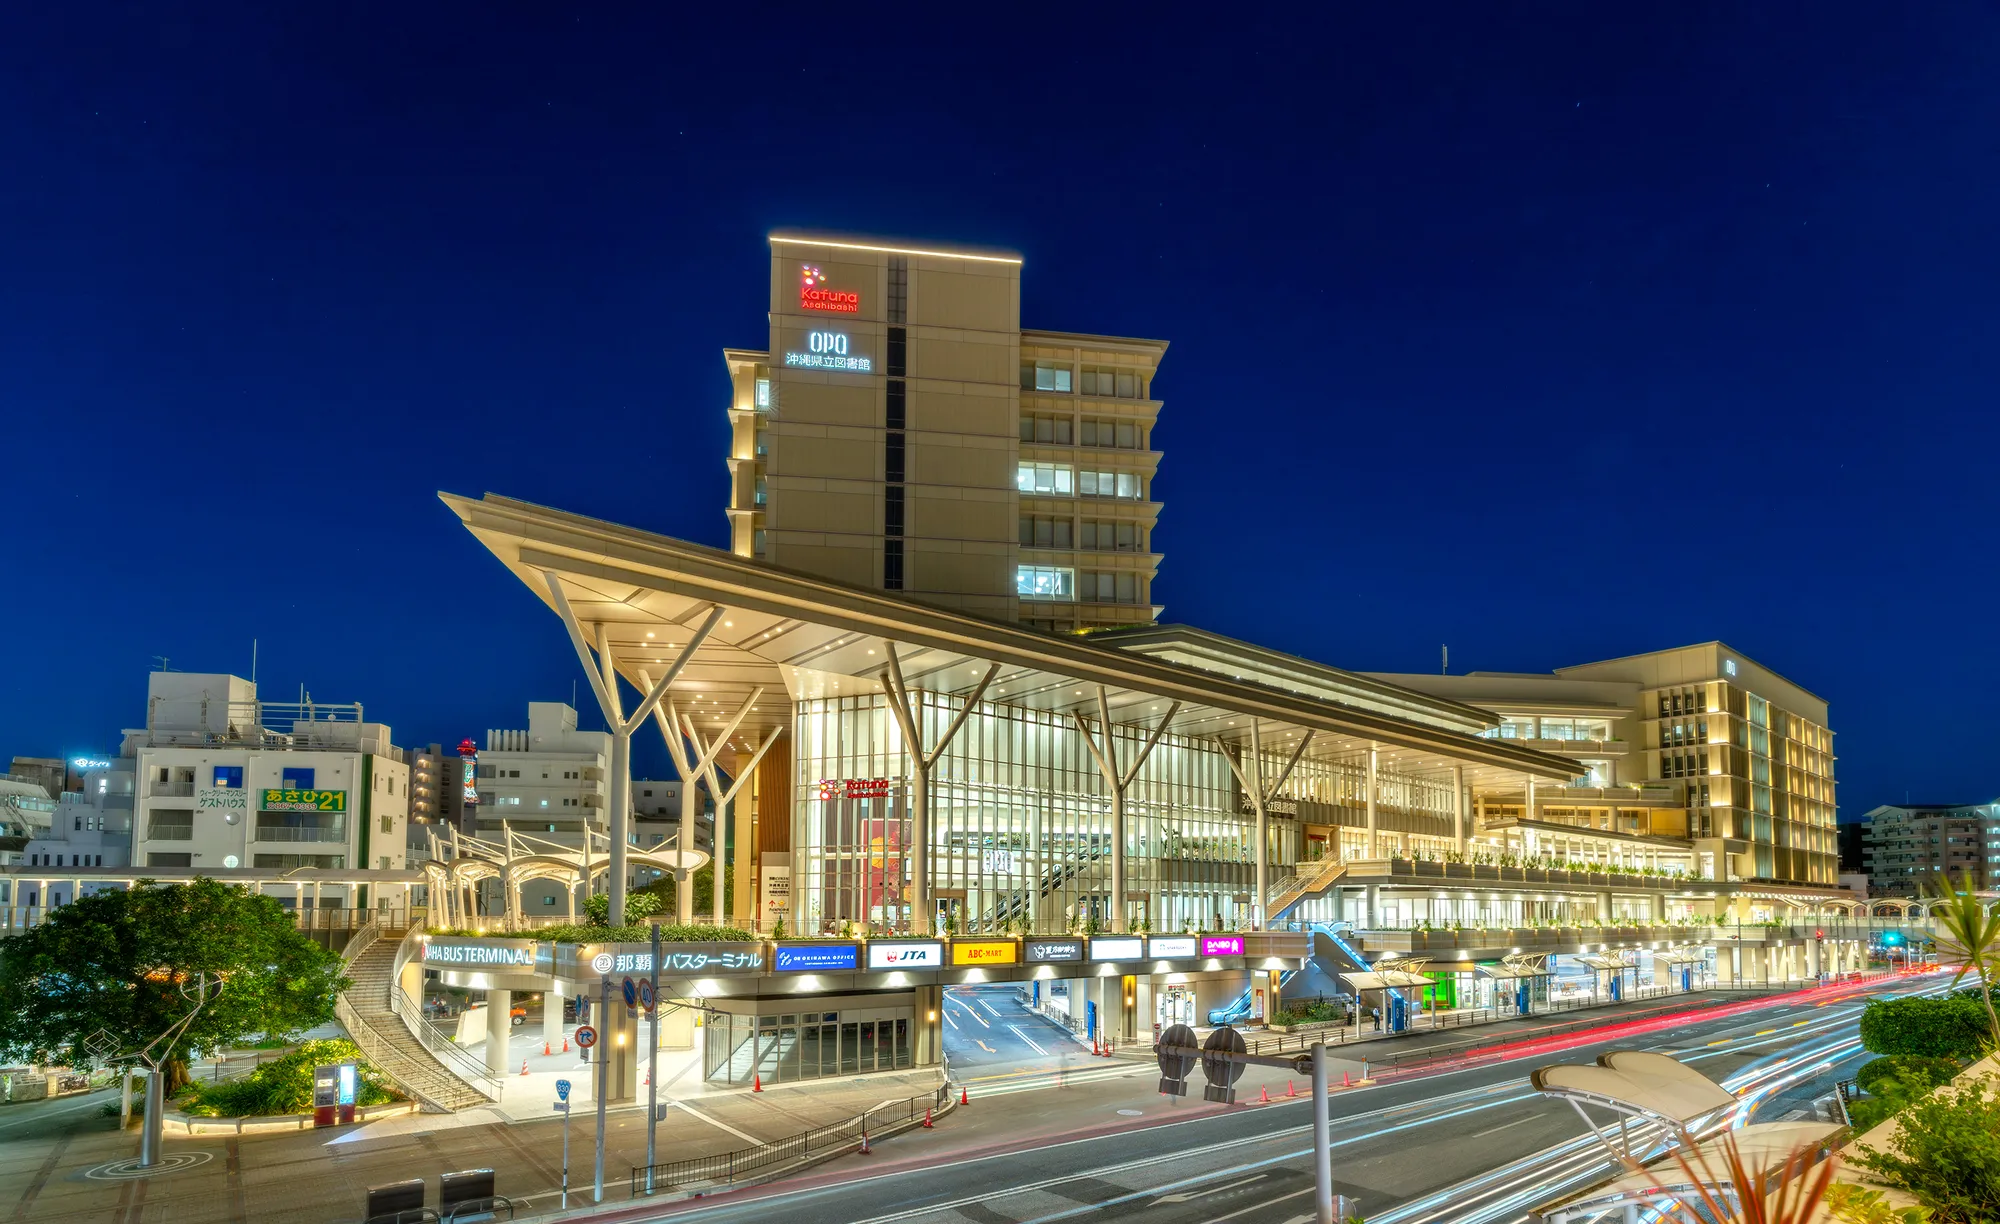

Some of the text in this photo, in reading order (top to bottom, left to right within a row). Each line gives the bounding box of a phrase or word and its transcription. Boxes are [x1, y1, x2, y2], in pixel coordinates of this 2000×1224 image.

[801, 287, 858, 303] Kafuna
[802, 300, 857, 312] Asahibashi
[786, 353, 870, 371] 沖縄県立図書館
[846, 779, 889, 790] Kafuna
[200, 797, 246, 808] ゲストハウス
[1207, 940, 1231, 949] DAISO
[424, 944, 534, 965] NAHA BUS TERMINAL
[899, 950, 927, 961] JTA
[967, 949, 1003, 958] ABC-MART
[616, 953, 763, 972] 那覇 バスターミナル
